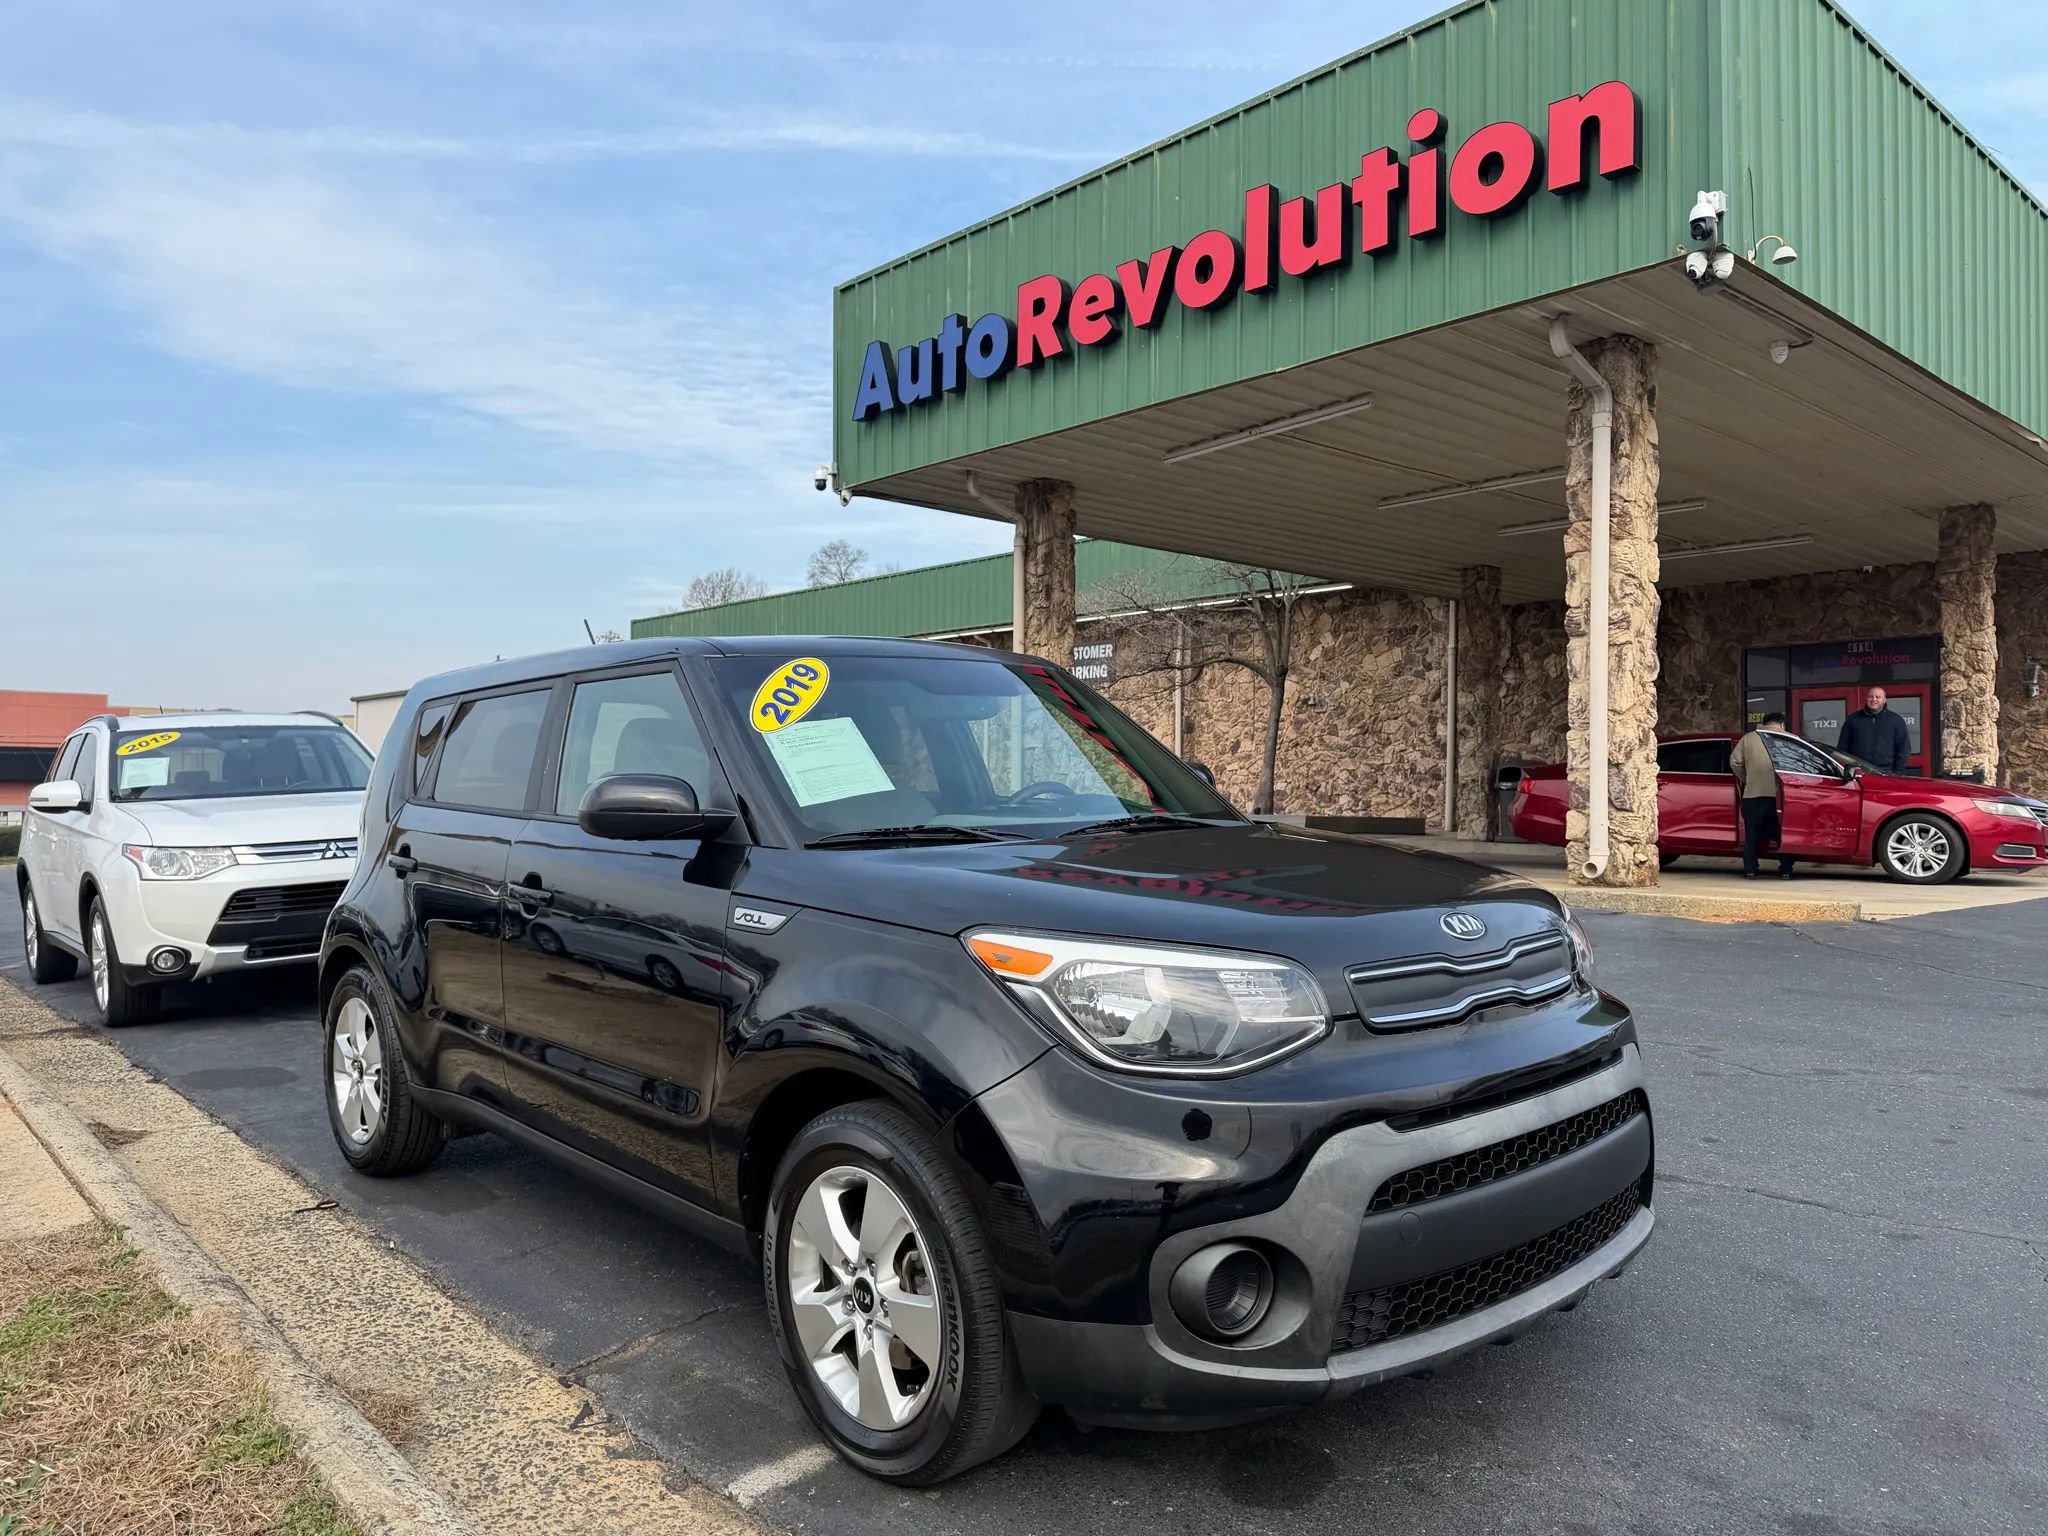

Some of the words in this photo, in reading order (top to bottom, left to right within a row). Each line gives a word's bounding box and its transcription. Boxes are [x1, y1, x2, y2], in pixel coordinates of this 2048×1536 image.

[1073, 644, 1113, 660] STOMER
[1071, 664, 1108, 680] ARKING
[760, 663, 820, 725] 2019
[125, 734, 172, 752] 2015
[1445, 914, 1483, 934] KIA
[854, 1286, 871, 1306] KIA
